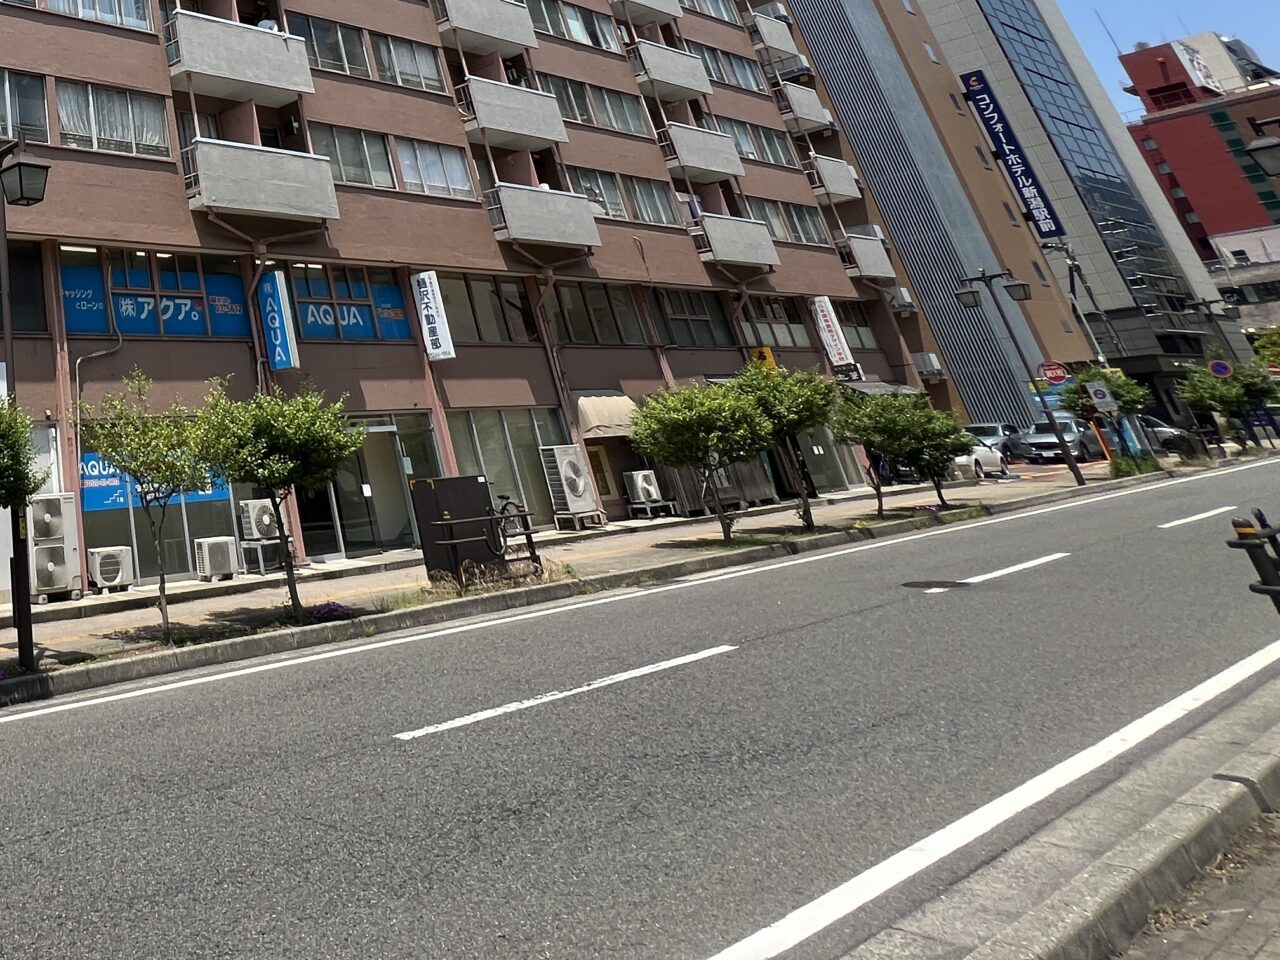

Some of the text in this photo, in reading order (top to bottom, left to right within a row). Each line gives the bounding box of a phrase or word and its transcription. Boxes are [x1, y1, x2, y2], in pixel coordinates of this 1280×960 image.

[976, 93, 1056, 233] コンフォートホテル新潟駅前
[266, 297, 287, 362] AQUA
[307, 304, 363, 326] AQUA
